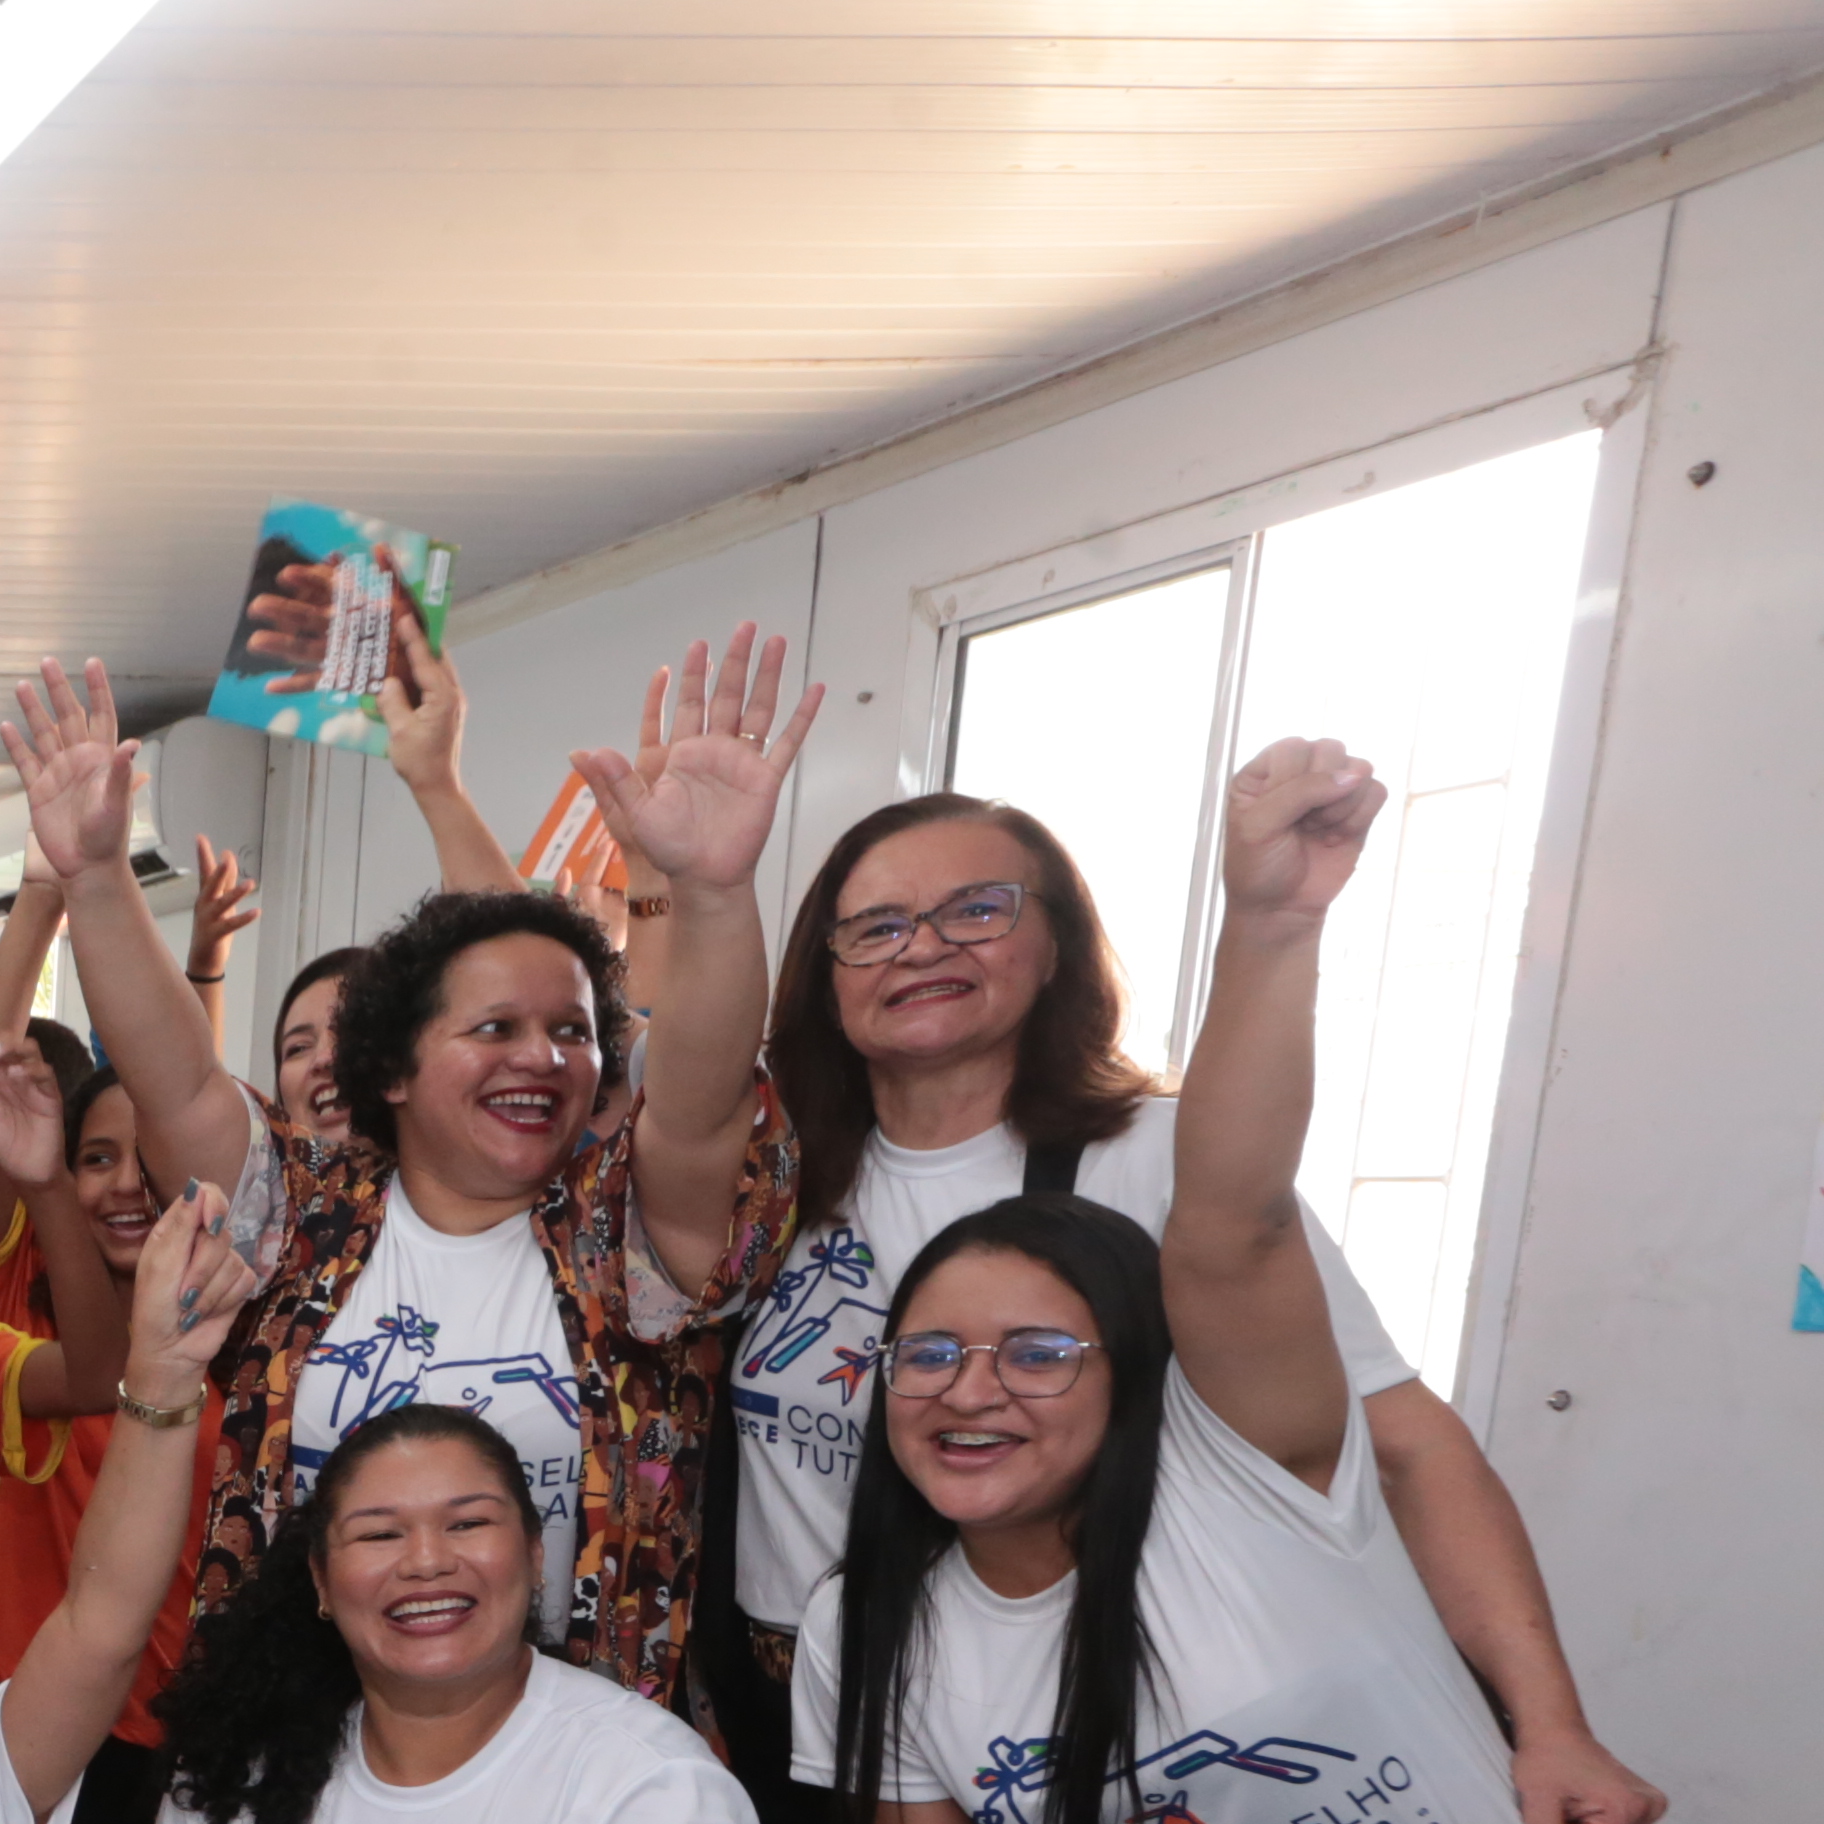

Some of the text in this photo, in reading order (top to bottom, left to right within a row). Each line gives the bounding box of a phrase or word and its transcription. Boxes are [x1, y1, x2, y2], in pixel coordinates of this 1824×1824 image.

[313, 558, 355, 693] Enfrentamento
[350, 635, 373, 696] contra
[736, 1414, 779, 1445] ECE
